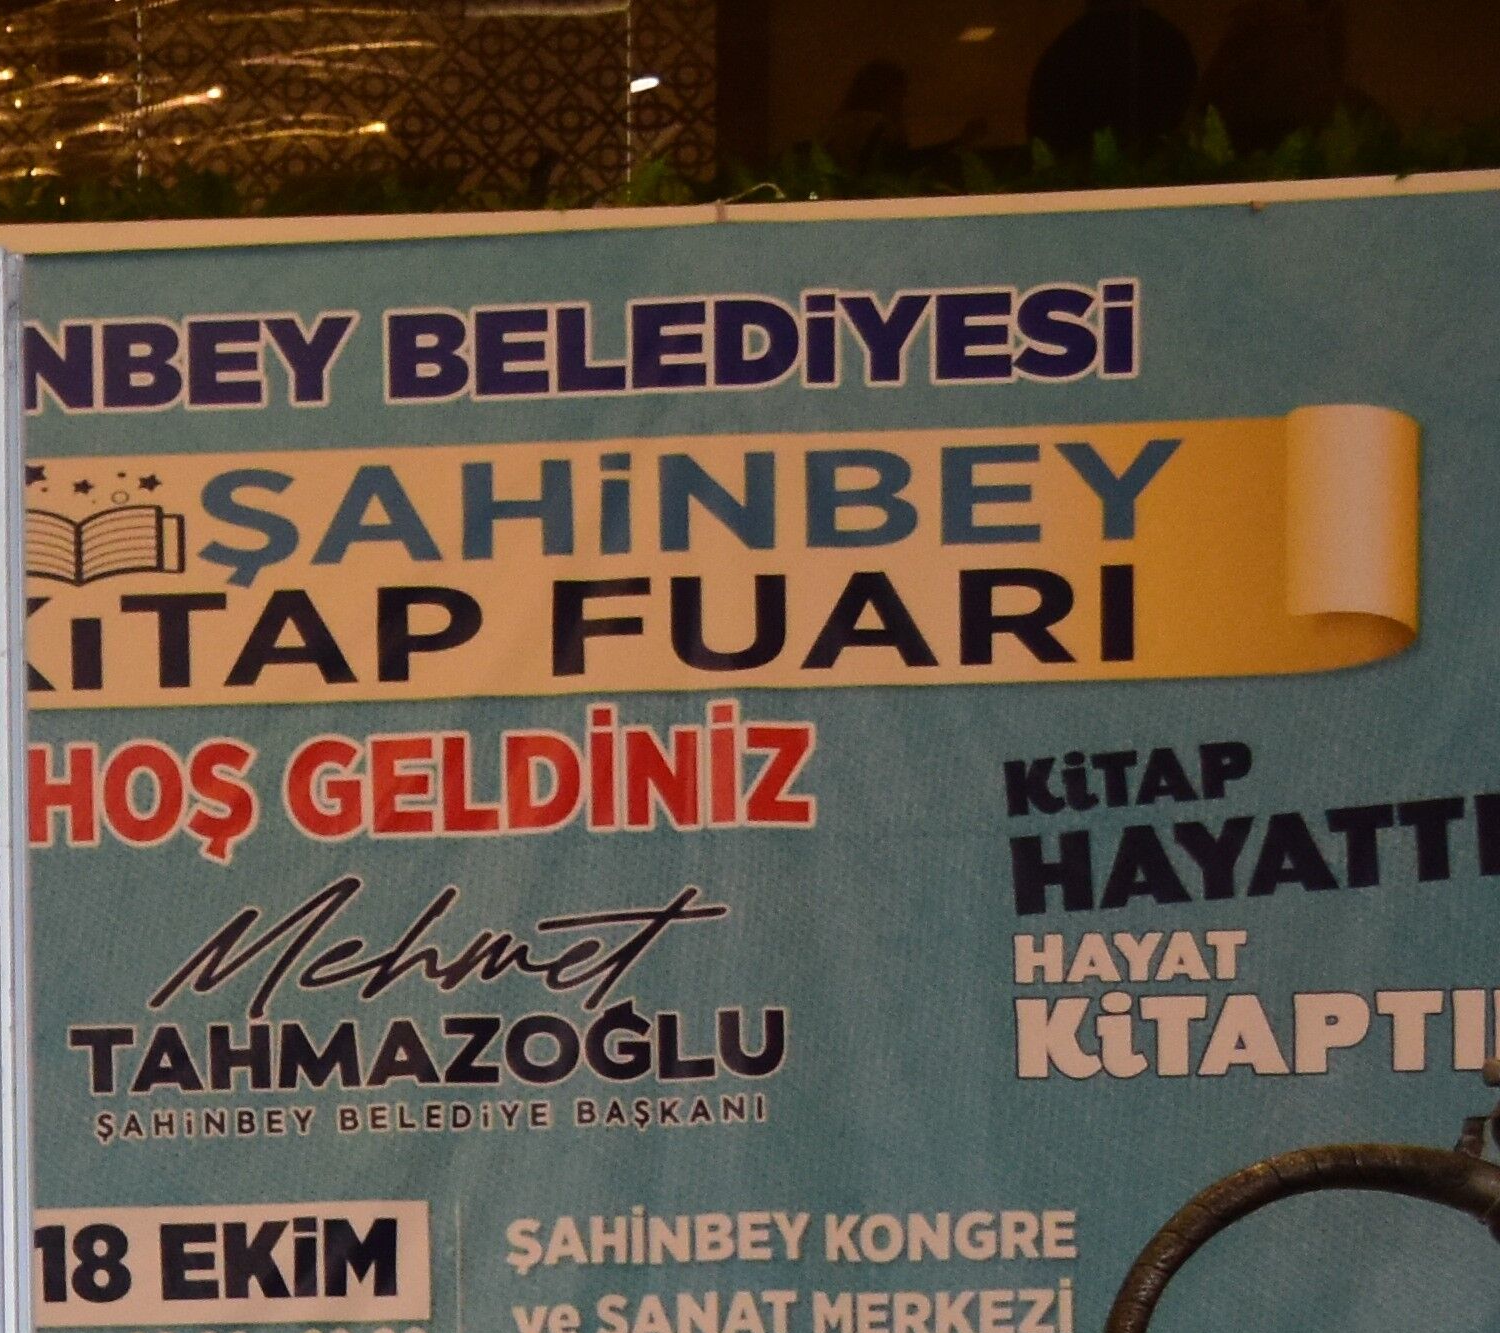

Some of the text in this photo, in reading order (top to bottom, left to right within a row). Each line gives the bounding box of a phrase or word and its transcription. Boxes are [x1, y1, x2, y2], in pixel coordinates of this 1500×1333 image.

[552, 563, 1136, 677] FUARI
[28, 702, 816, 862] HOŞ GELDİNİZ
[1010, 793, 1500, 916] HAYATTI
[148, 878, 727, 1020] Mehmet
[1013, 930, 1248, 985] HAYAT
[68, 1003, 787, 1094] TAHMAZOĞLU
[1014, 988, 1500, 1080] KİTAPTI
[576, 1096, 769, 1129] BAŞKANI
[505, 1203, 1078, 1278] ŞAHİNBEY KONGRE
